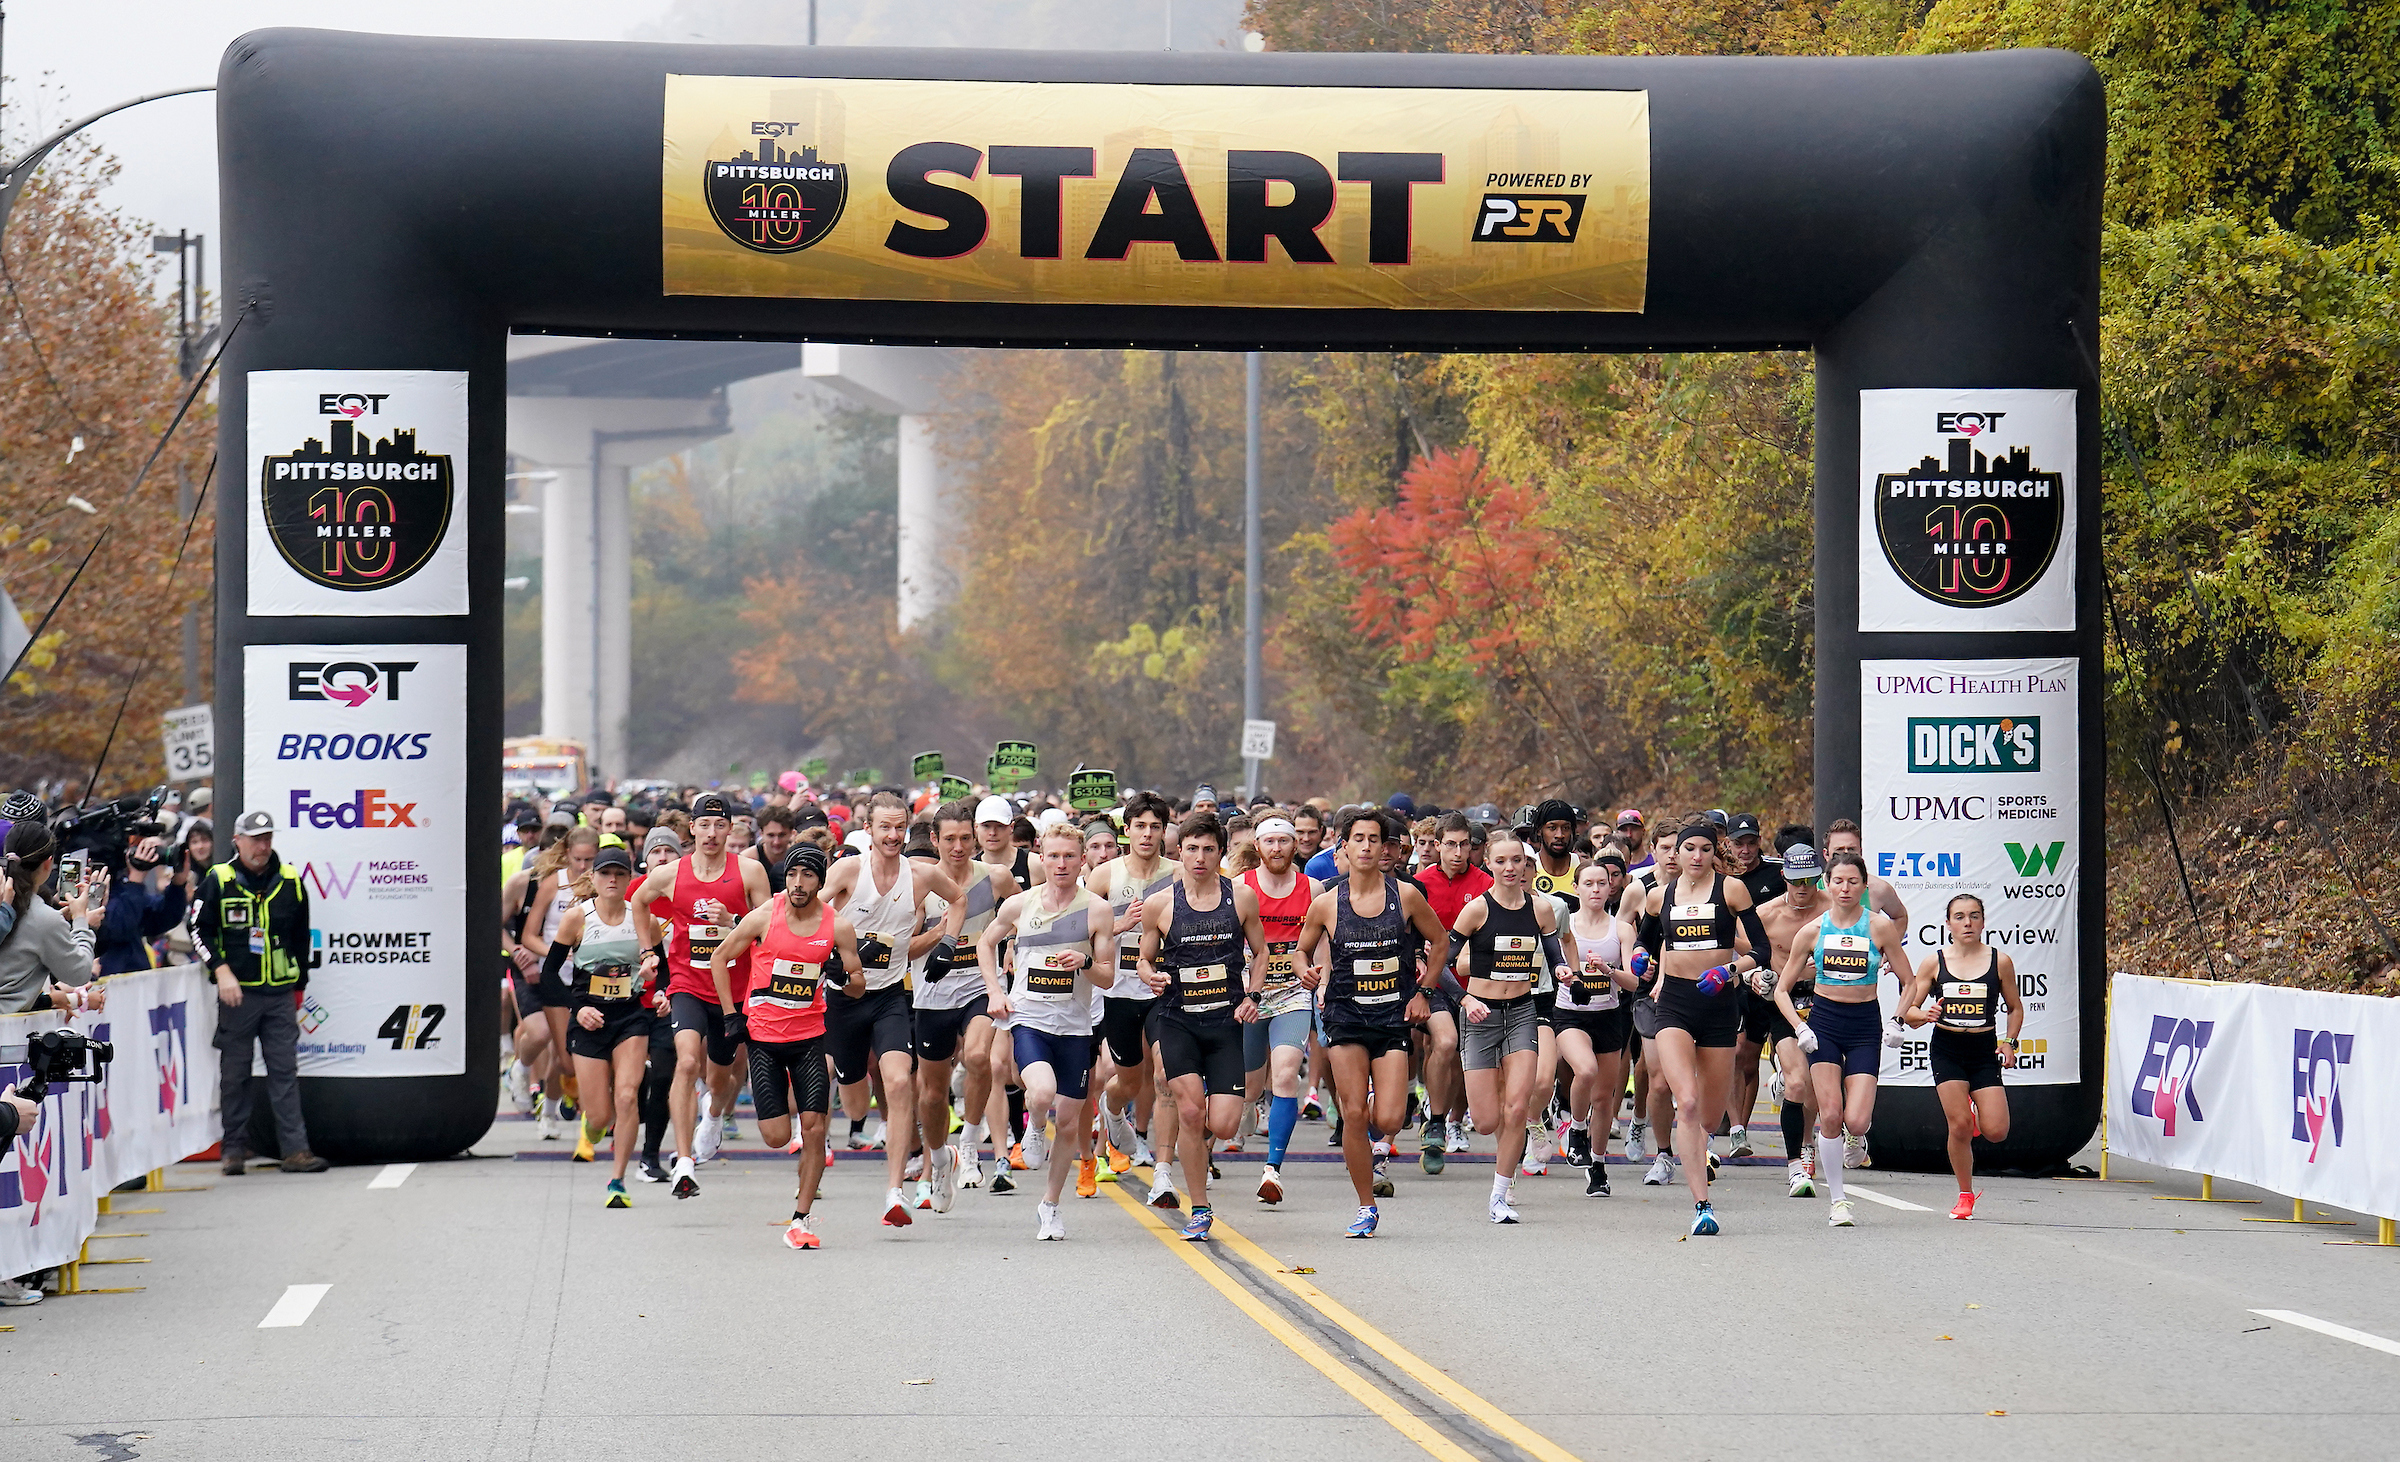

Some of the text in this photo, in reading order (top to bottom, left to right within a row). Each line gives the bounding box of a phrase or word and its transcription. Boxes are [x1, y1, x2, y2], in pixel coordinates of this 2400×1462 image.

[751, 121, 800, 138] EQT
[716, 165, 834, 182] PITTSBURGH
[1486, 173, 1592, 189] POWERED BY
[885, 141, 1446, 266] START
[741, 183, 804, 245] 10
[748, 208, 801, 221] MILER
[1481, 199, 1571, 237] P3R
[319, 392, 391, 418] EQT
[1937, 411, 2007, 436] EQT
[275, 462, 438, 481] PITTSBURGH
[1890, 480, 2050, 498] PITTSBURGH
[307, 486, 396, 577] 10
[316, 525, 392, 538] MILER
[1925, 504, 2011, 594] 10
[1933, 543, 2007, 555] MILER
[289, 661, 419, 708] EQT
[1876, 676, 1943, 694] UPMC
[277, 733, 432, 760] BROOKS
[1246, 740, 1269, 755] 35
[1914, 722, 2035, 767] DICK'S
[174, 742, 212, 771] 35
[1000, 754, 1026, 766] 7:00
[1074, 787, 1101, 797] 6:30
[290, 788, 418, 828] FedEx
[1890, 795, 2047, 820] UPMC SPORTS
[1998, 809, 2057, 820] MEDICINE
[369, 861, 419, 870] MAGEE-
[1878, 852, 1961, 877] EATON
[370, 874, 428, 884] WOMENS
[1894, 881, 1992, 891] Powering Business Worldwide
[2003, 883, 2066, 899] wesco
[1676, 925, 1711, 937] ORIE
[329, 932, 432, 948] HOWMET
[328, 951, 432, 964] AEROSPACE
[1824, 955, 1867, 967] MAZUR
[1267, 961, 1292, 971] 366
[772, 981, 812, 997] LARA
[1029, 976, 1073, 986] LOEVNER
[1357, 977, 1397, 991] HUNT
[1583, 981, 1610, 990] NNEN
[602, 984, 620, 995] 113
[1183, 986, 1227, 997] LEACHMAN
[1946, 1003, 1984, 1015] HYDE
[2030, 1002, 2046, 1012] PENN
[328, 1042, 366, 1055] Authority
[2131, 1014, 2215, 1137] EQT
[2292, 1028, 2355, 1164] EQT
